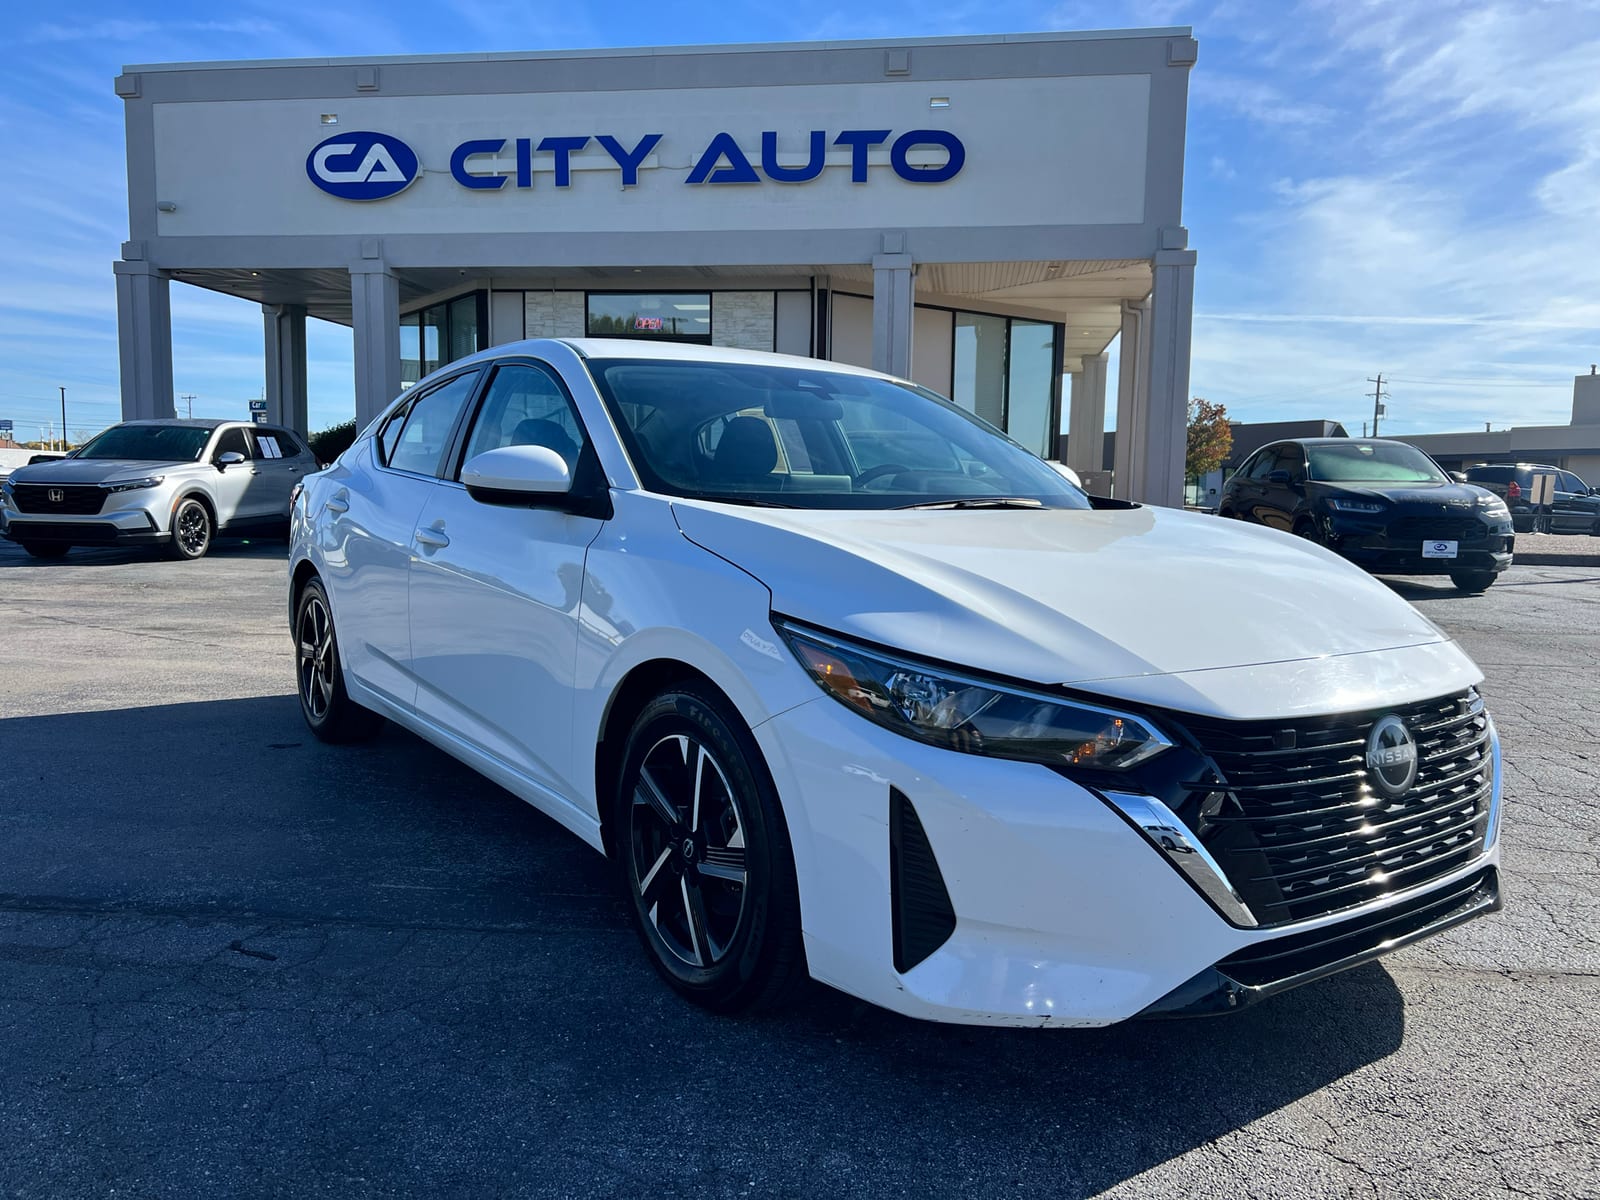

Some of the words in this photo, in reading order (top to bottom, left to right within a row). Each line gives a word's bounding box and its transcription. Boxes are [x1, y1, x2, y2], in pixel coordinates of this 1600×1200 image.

[312, 142, 408, 184] CA
[450, 134, 663, 189] CITY
[685, 130, 965, 184] AUTO
[636, 317, 661, 329] OPEN
[1370, 742, 1416, 765] NISSAN
